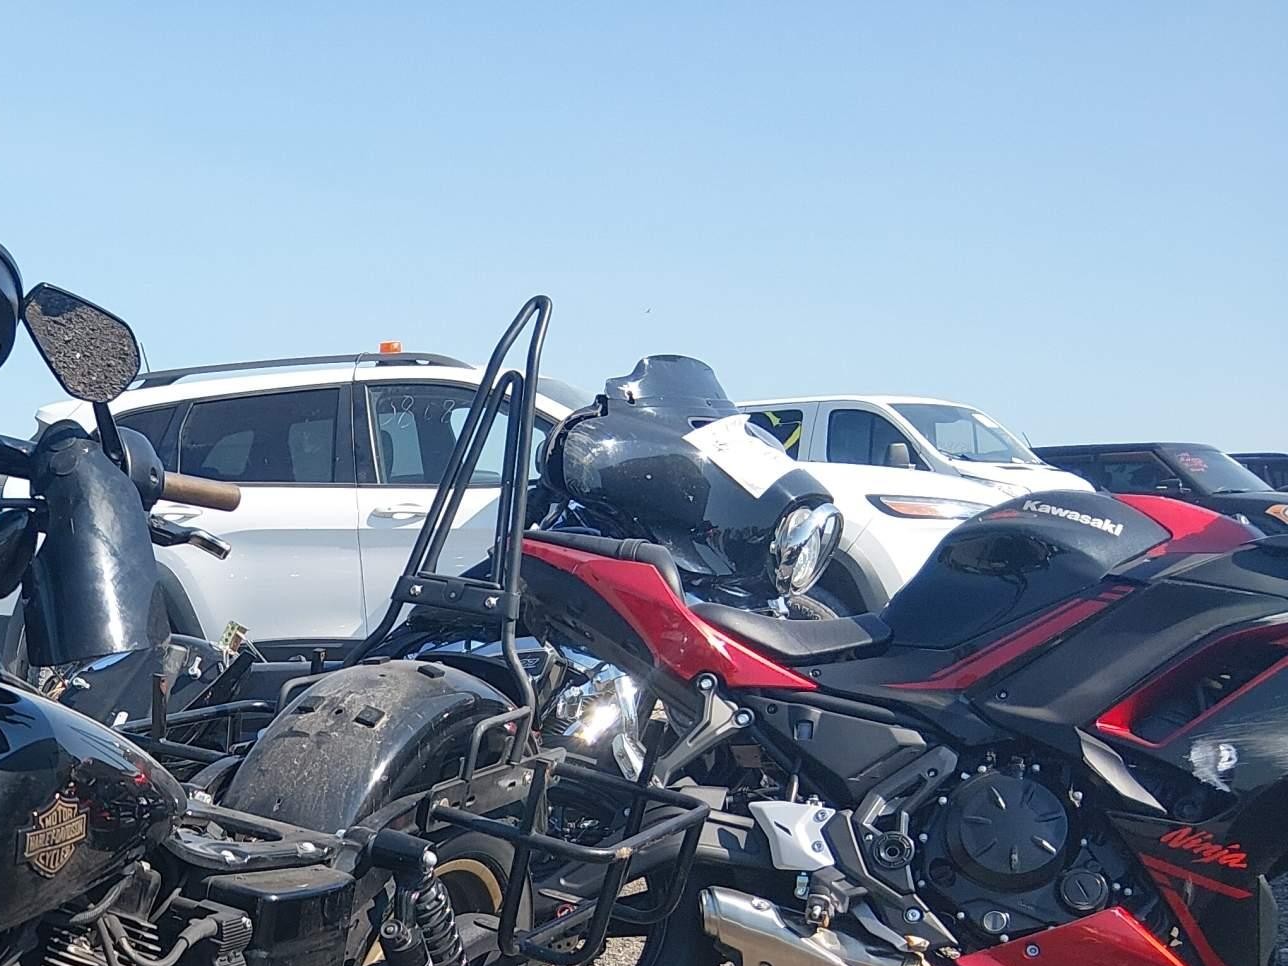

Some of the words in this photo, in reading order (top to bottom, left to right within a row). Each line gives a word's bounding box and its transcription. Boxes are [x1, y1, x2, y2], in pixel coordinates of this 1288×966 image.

[1023, 500, 1124, 537] Kawasaki
[45, 806, 73, 827] MOTOR
[1160, 827, 1248, 869] Ninja
